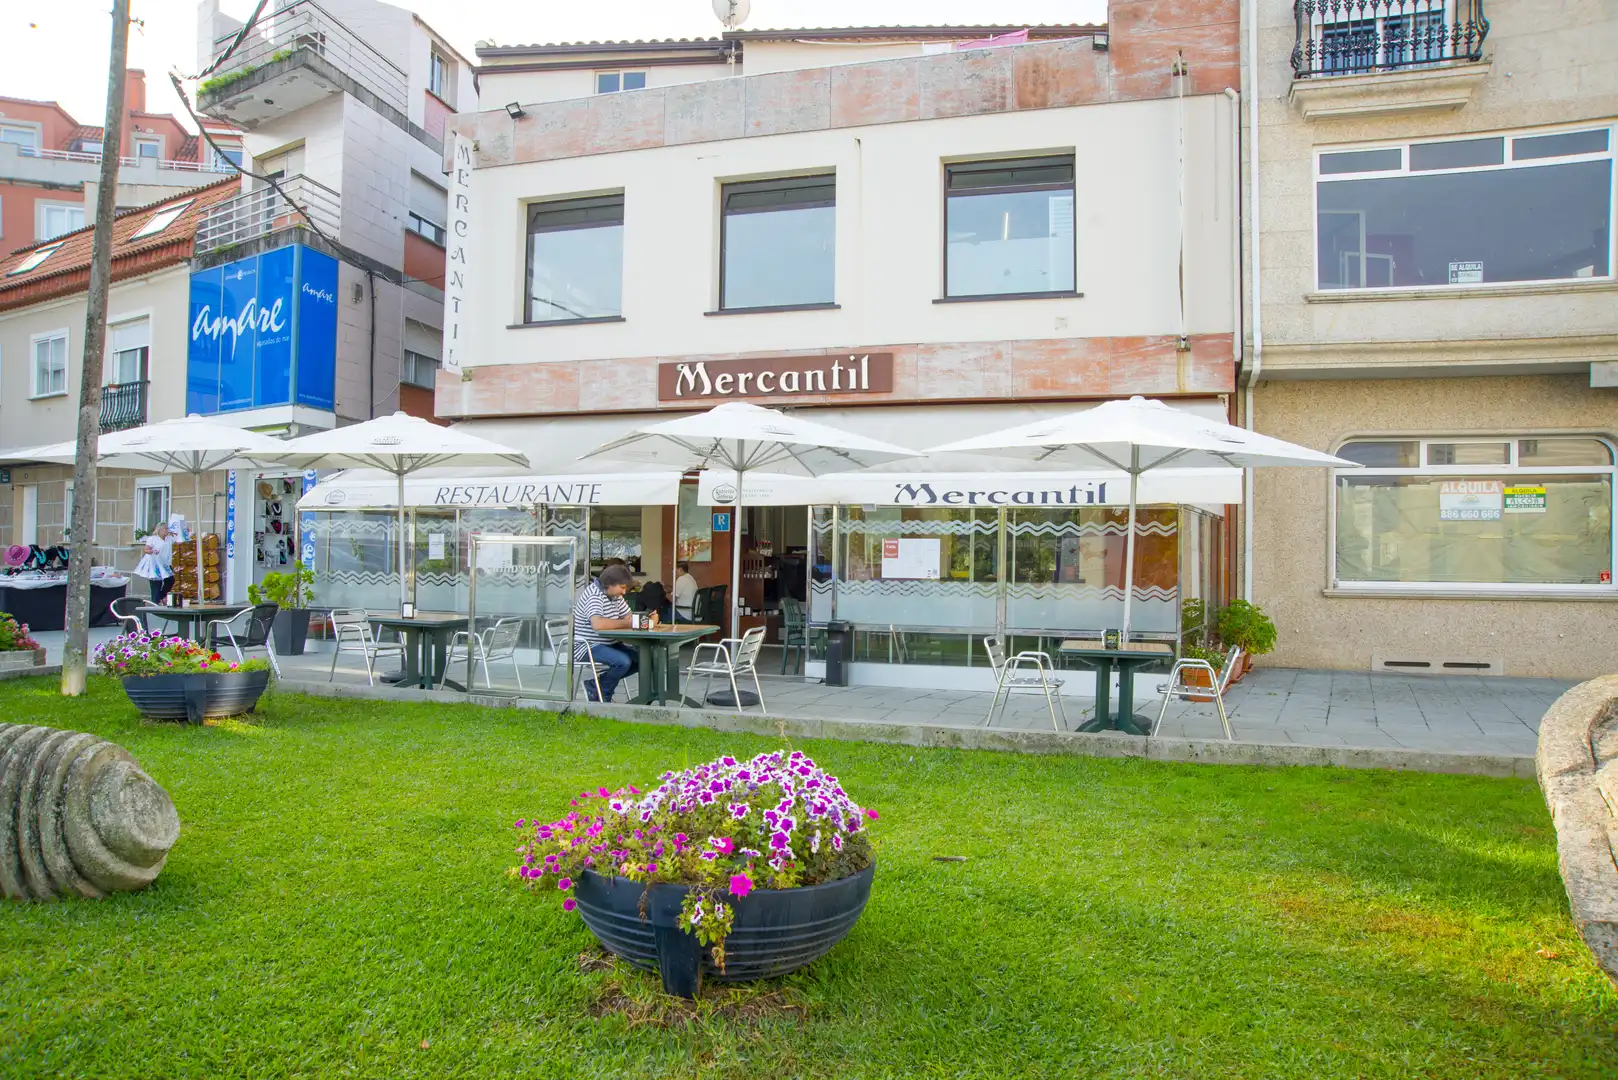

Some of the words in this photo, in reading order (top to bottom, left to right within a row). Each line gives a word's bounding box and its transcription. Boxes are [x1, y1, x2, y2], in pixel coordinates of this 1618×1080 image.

[448, 143, 471, 366] MERCANTIL
[675, 354, 869, 396] Mercantil
[434, 483, 602, 505] RESTAURANTE
[894, 481, 1107, 505] Mercantil
[1441, 480, 1499, 493] ALQUILA
